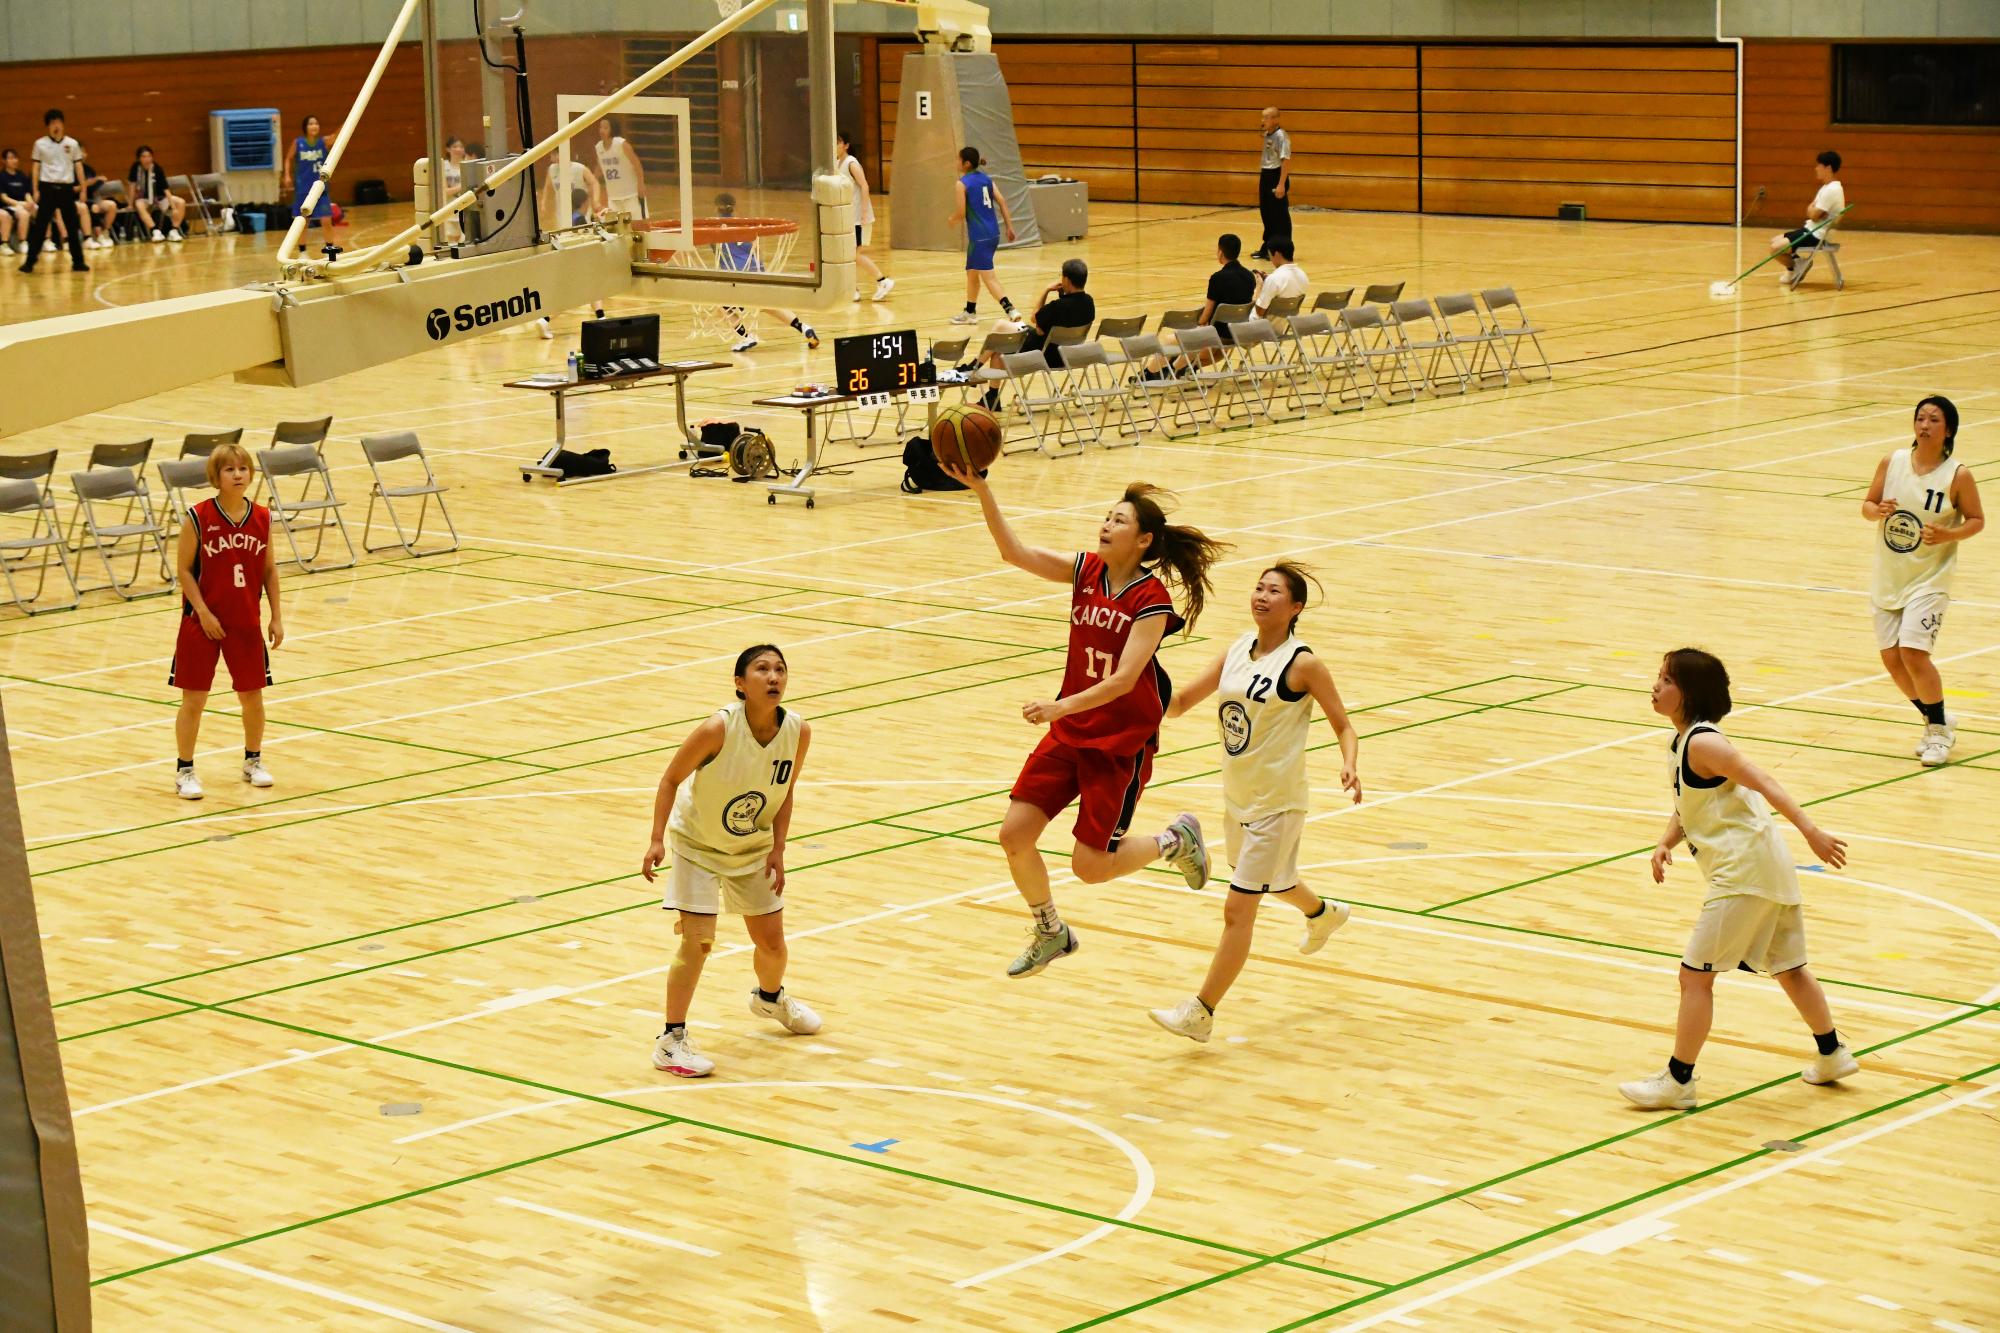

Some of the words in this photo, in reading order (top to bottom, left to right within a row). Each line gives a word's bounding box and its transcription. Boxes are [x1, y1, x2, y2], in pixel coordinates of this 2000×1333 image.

[920, 96, 927, 116] E
[606, 169, 620, 180] 82
[982, 185, 992, 209] 4
[453, 287, 542, 332] Senoh
[872, 335, 902, 359] 1:54
[849, 368, 869, 391] 26
[898, 362, 917, 386] 37
[1924, 488, 1944, 513] 11
[203, 533, 267, 558] KAICITY
[233, 563, 247, 588] 6
[1071, 604, 1132, 634] KAICIT
[1084, 646, 1113, 681] 17
[1246, 673, 1273, 704] 12
[770, 759, 793, 786] 10
